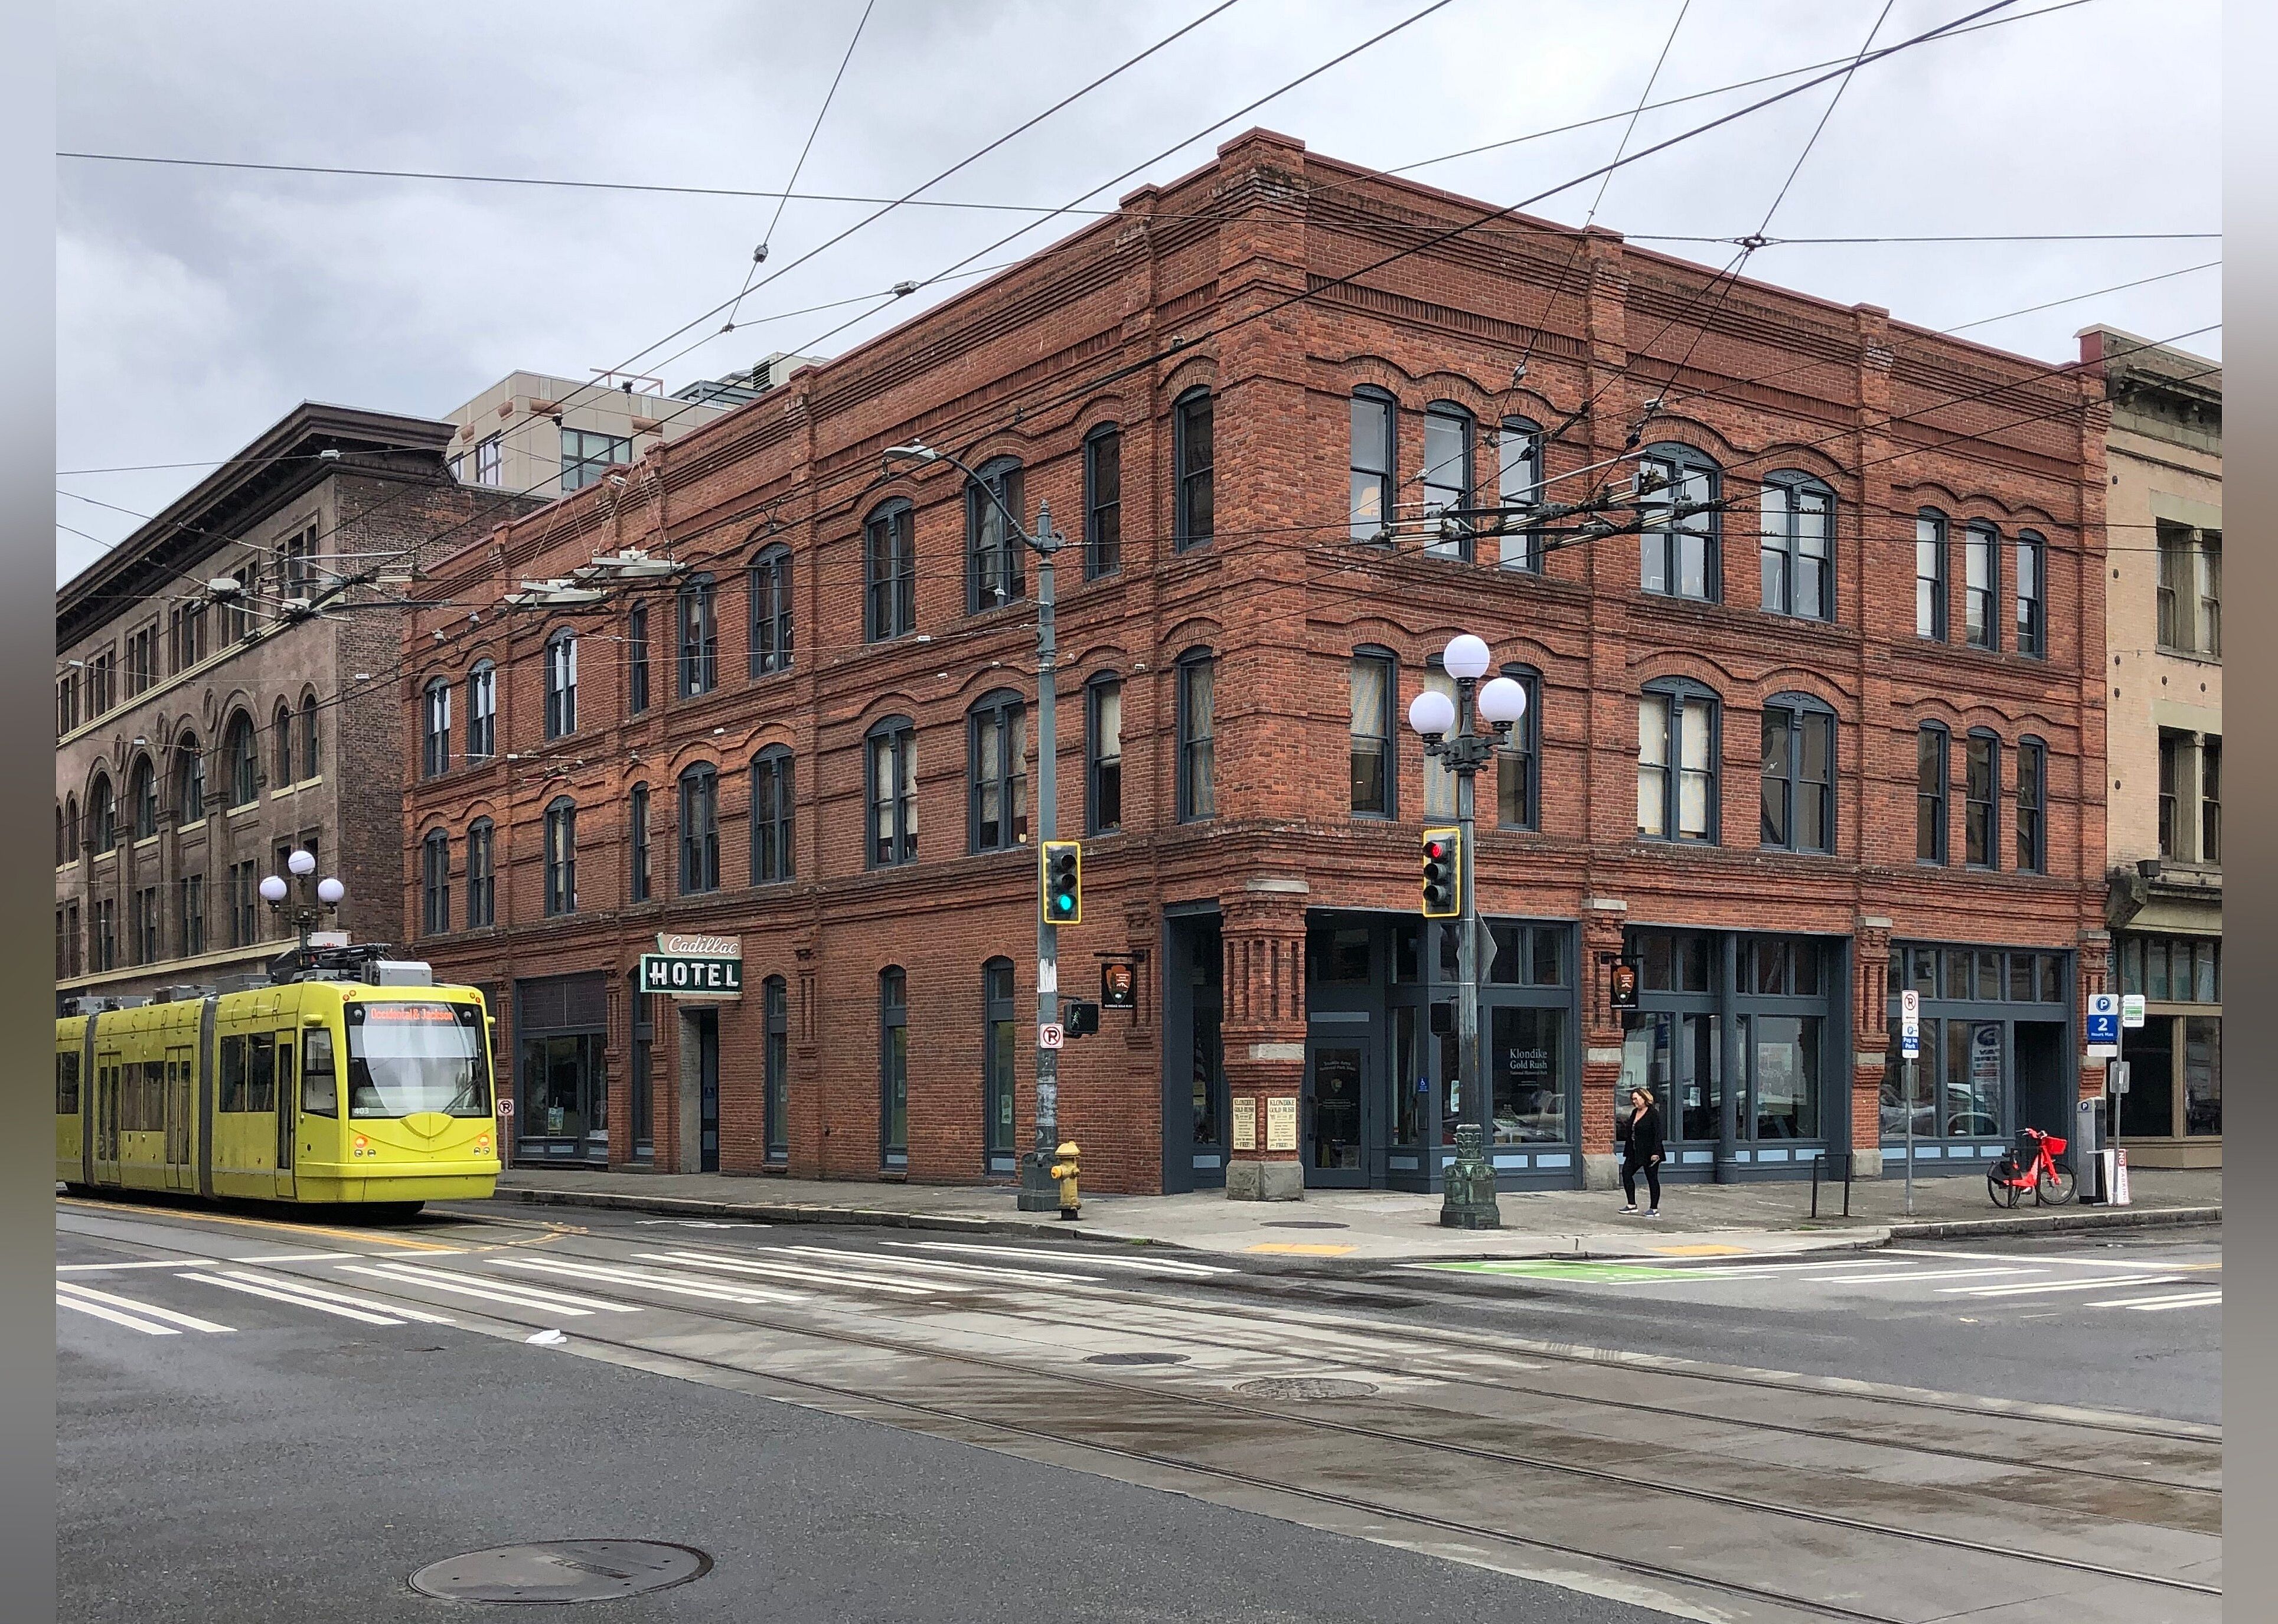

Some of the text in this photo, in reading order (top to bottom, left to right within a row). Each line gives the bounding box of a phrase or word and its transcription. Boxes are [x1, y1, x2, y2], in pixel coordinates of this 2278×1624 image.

[668, 936, 738, 955] Cadillac
[650, 962, 739, 987] HOTEL
[2100, 999, 2108, 1009] P
[421, 1008, 453, 1021] Jackson
[2097, 1017, 2108, 1031] 2
[1510, 1048, 1548, 1058] Klondike
[1510, 1060, 1548, 1069] Gold Rush
[2118, 1152, 2124, 1165] NO
